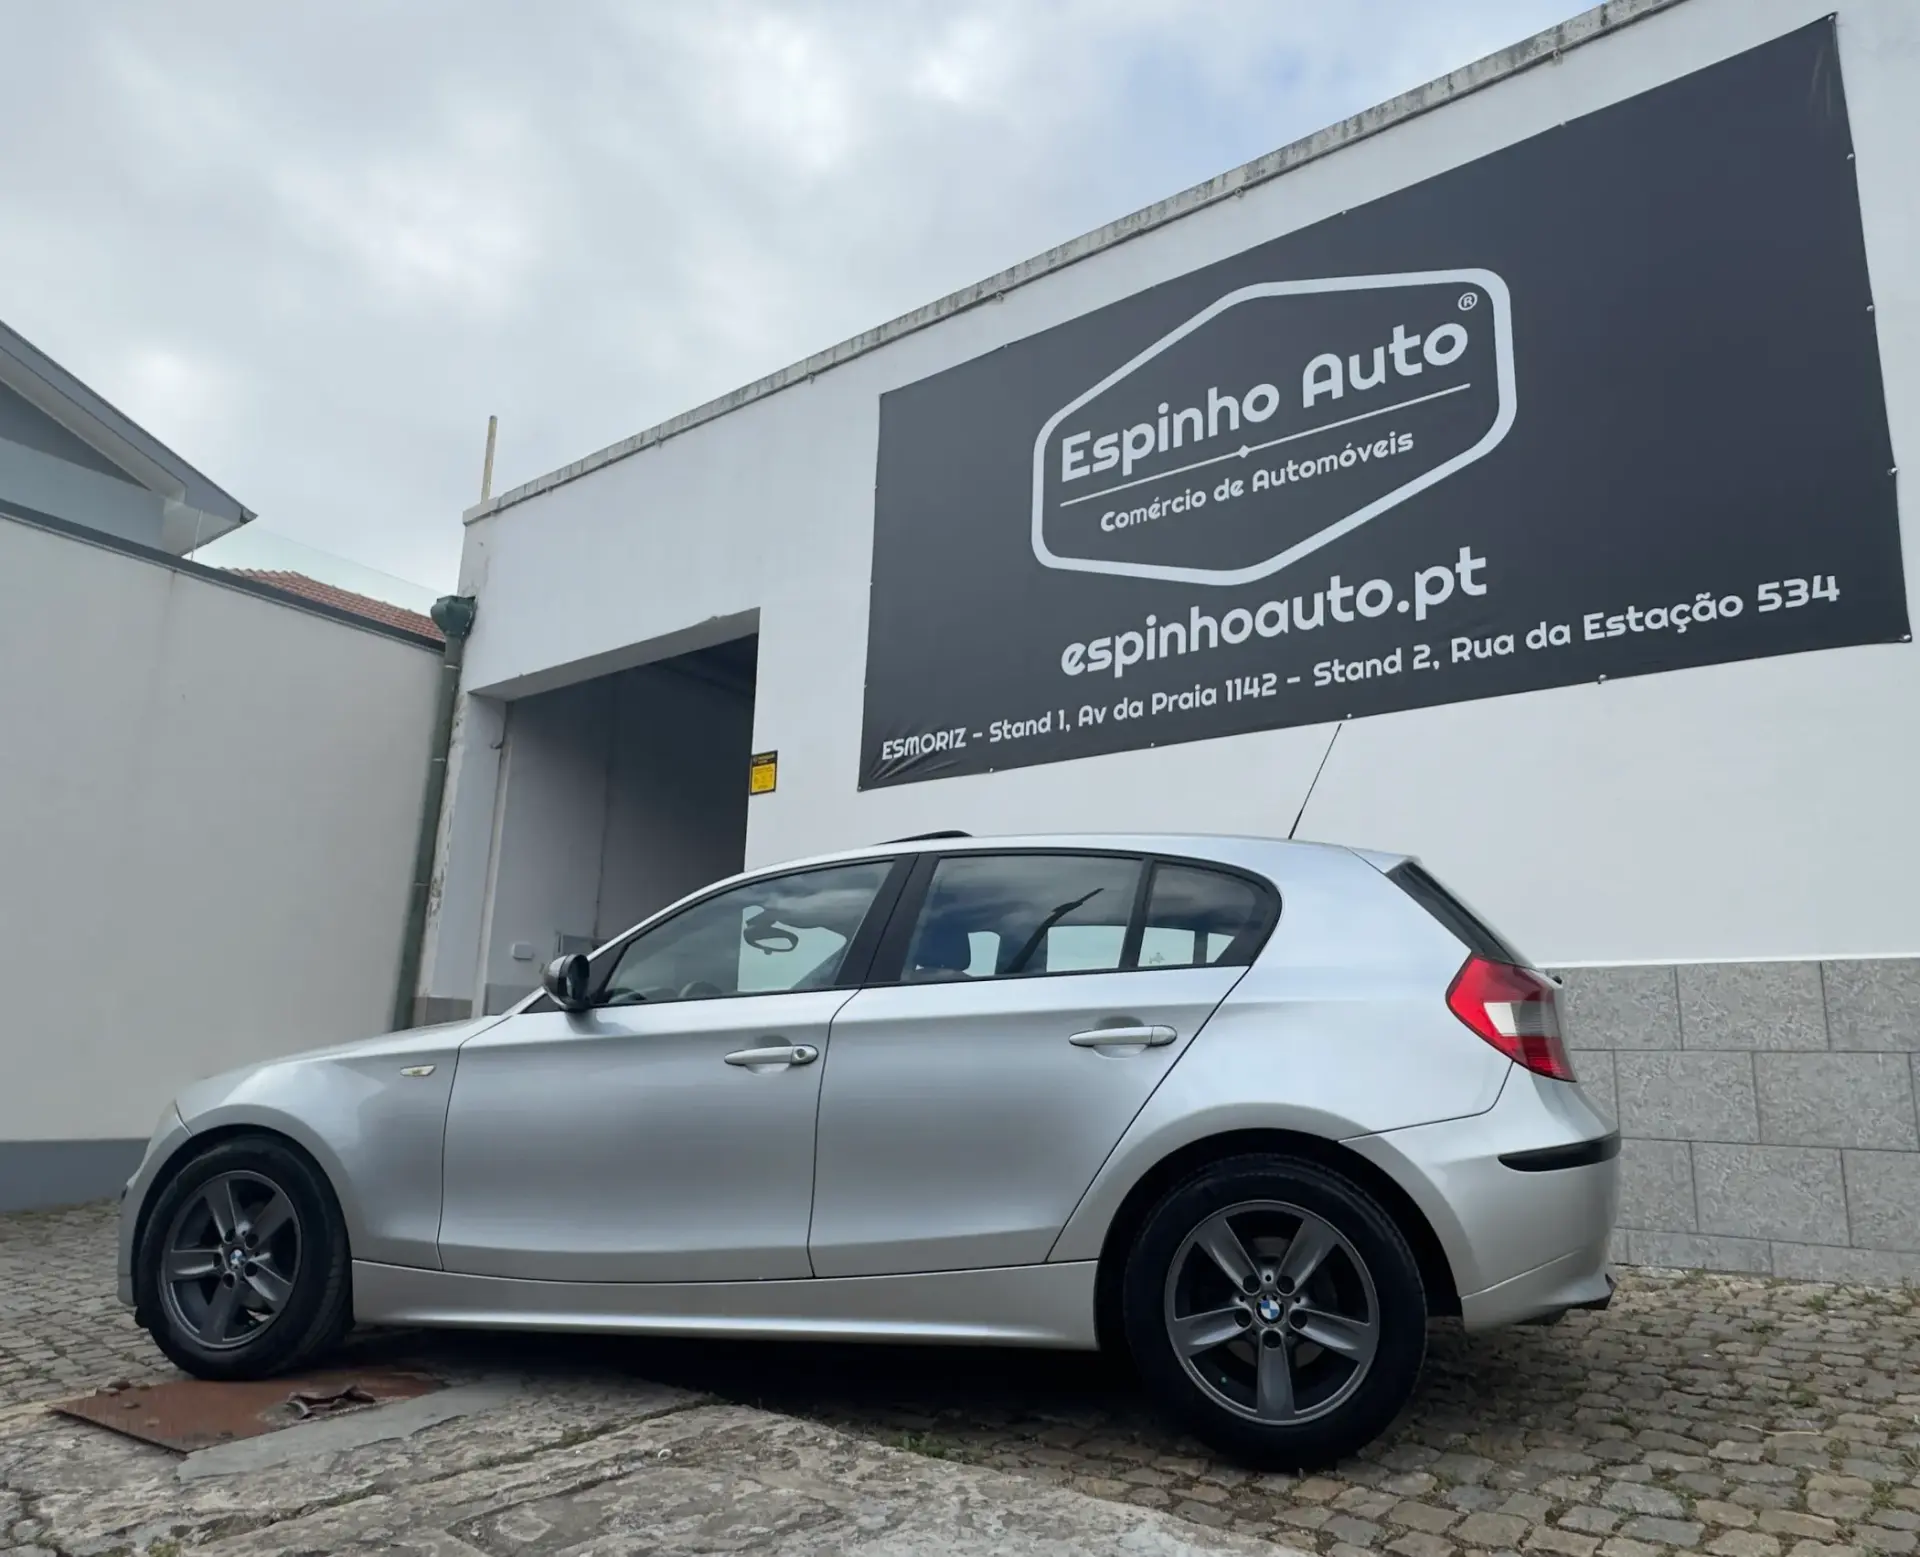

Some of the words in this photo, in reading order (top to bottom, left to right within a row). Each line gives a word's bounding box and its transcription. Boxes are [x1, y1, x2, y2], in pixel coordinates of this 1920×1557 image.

[1061, 384, 1280, 482] Espinho
[1302, 323, 1468, 408] Auto
[1100, 488, 1207, 532] Comércio
[1213, 477, 1245, 502] de
[1252, 430, 1414, 493] Automóveis
[881, 727, 968, 761] ESMORIZ
[989, 710, 1053, 743] Stand
[1058, 709, 1072, 733] 1,
[1078, 704, 1108, 727] Av
[1113, 697, 1144, 721] da
[1151, 683, 1217, 715] Praia
[1225, 672, 1278, 703] 1142
[1313, 647, 1403, 687] Stand
[1413, 644, 1441, 670] 2,
[1451, 634, 1515, 663] Rua
[1525, 621, 1571, 650] da
[1583, 592, 1744, 641] Estação
[1757, 574, 1840, 613] 534
[1061, 546, 1487, 678] espinhoauto.pt
